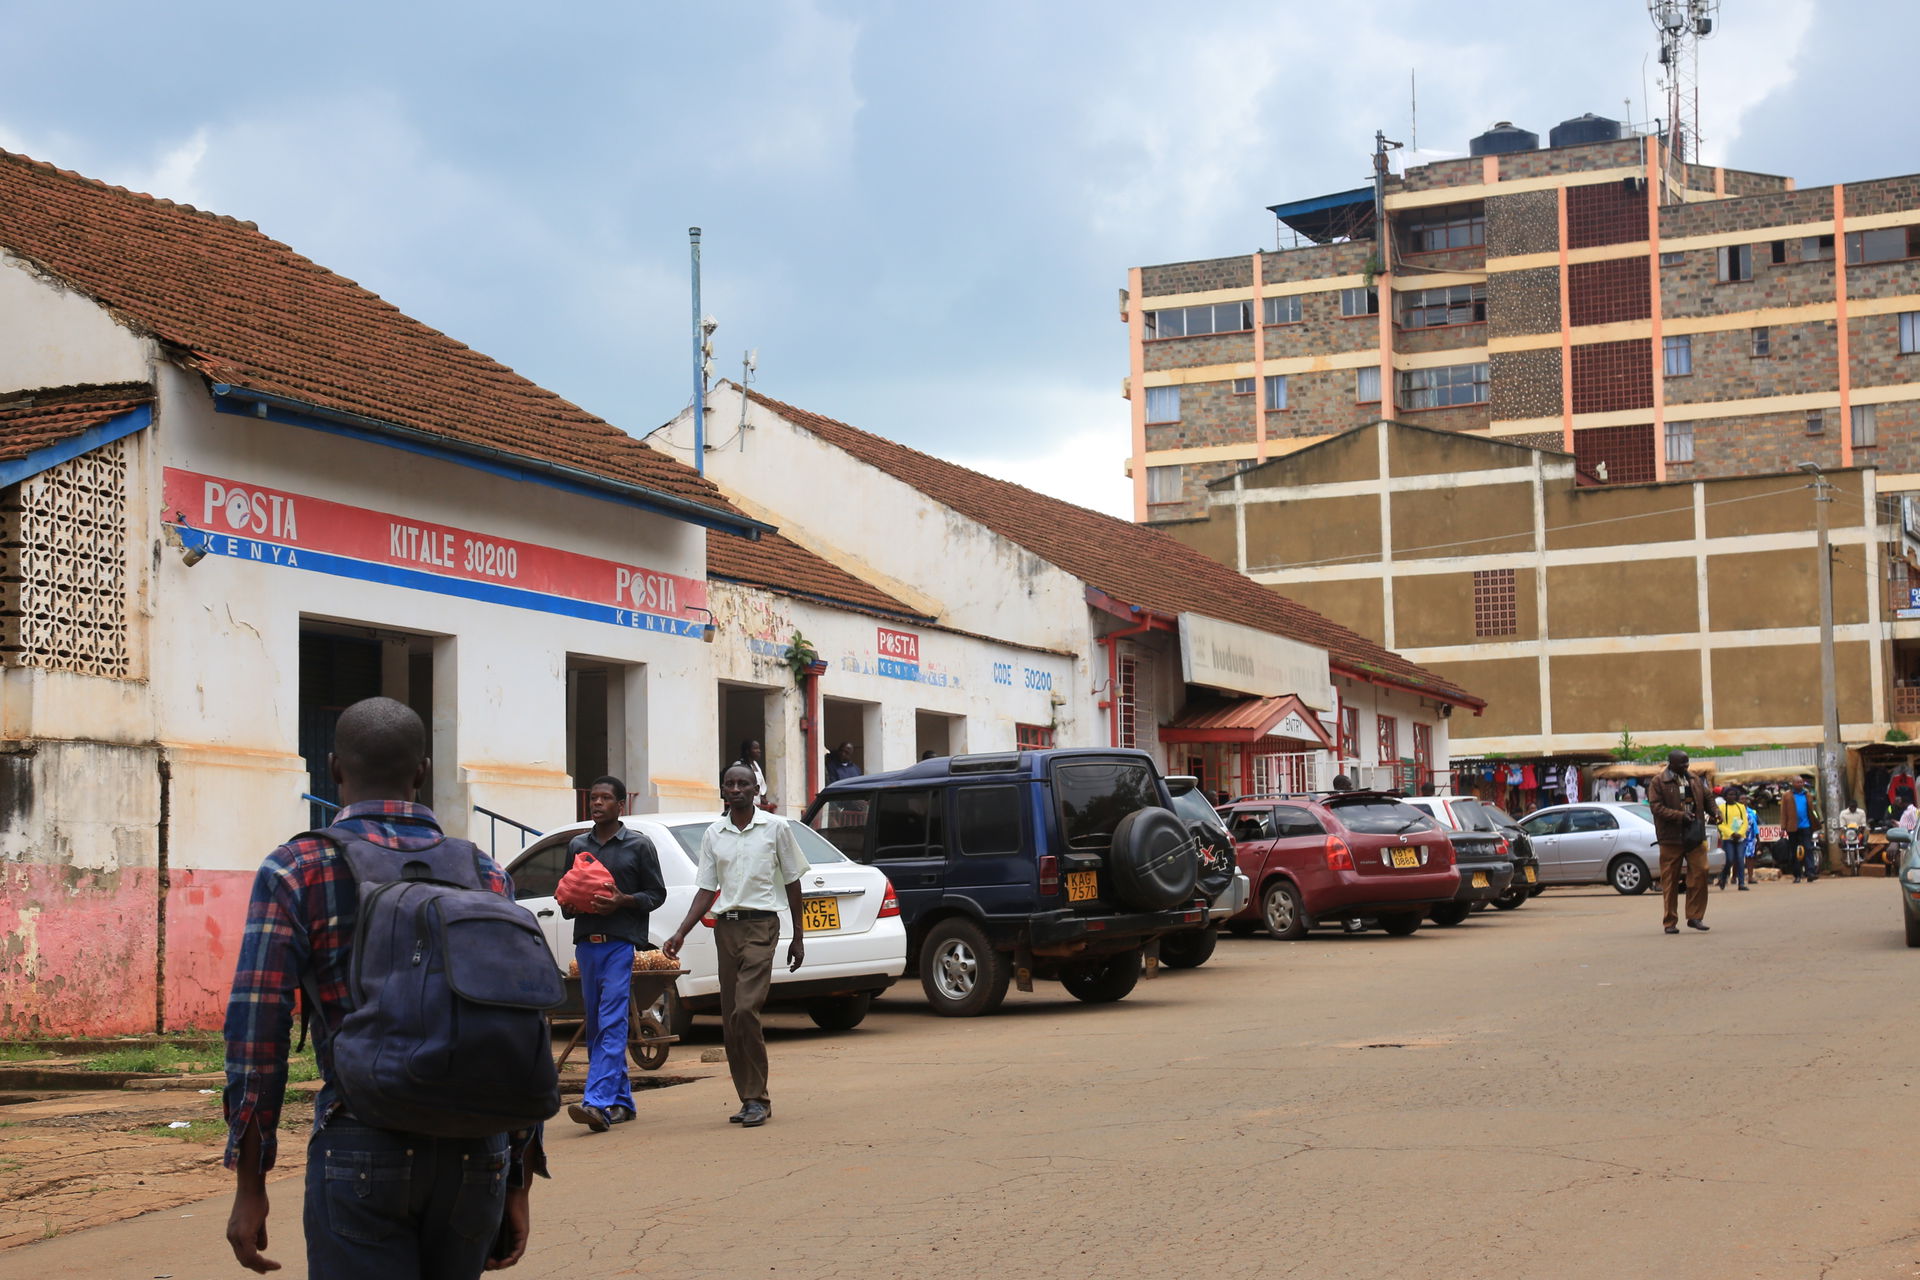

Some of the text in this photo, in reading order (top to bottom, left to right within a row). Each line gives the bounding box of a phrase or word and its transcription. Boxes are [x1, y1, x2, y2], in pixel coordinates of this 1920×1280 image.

[203, 481, 298, 540] POSTA
[203, 534, 298, 566] KENYA
[390, 523, 517, 579] KITALE 30200
[616, 567, 677, 613] POSTA
[616, 609, 677, 634] KENYA
[879, 631, 916, 657] POSTA
[1211, 640, 1255, 678] huduma
[993, 662, 1012, 686] CODE
[1024, 667, 1052, 691] 30200
[1285, 717, 1303, 734] ENTRY
[1071, 873, 1091, 887] KAG
[1072, 885, 1097, 900] 757D
[803, 900, 827, 915] KCE
[806, 913, 837, 928] 167E
